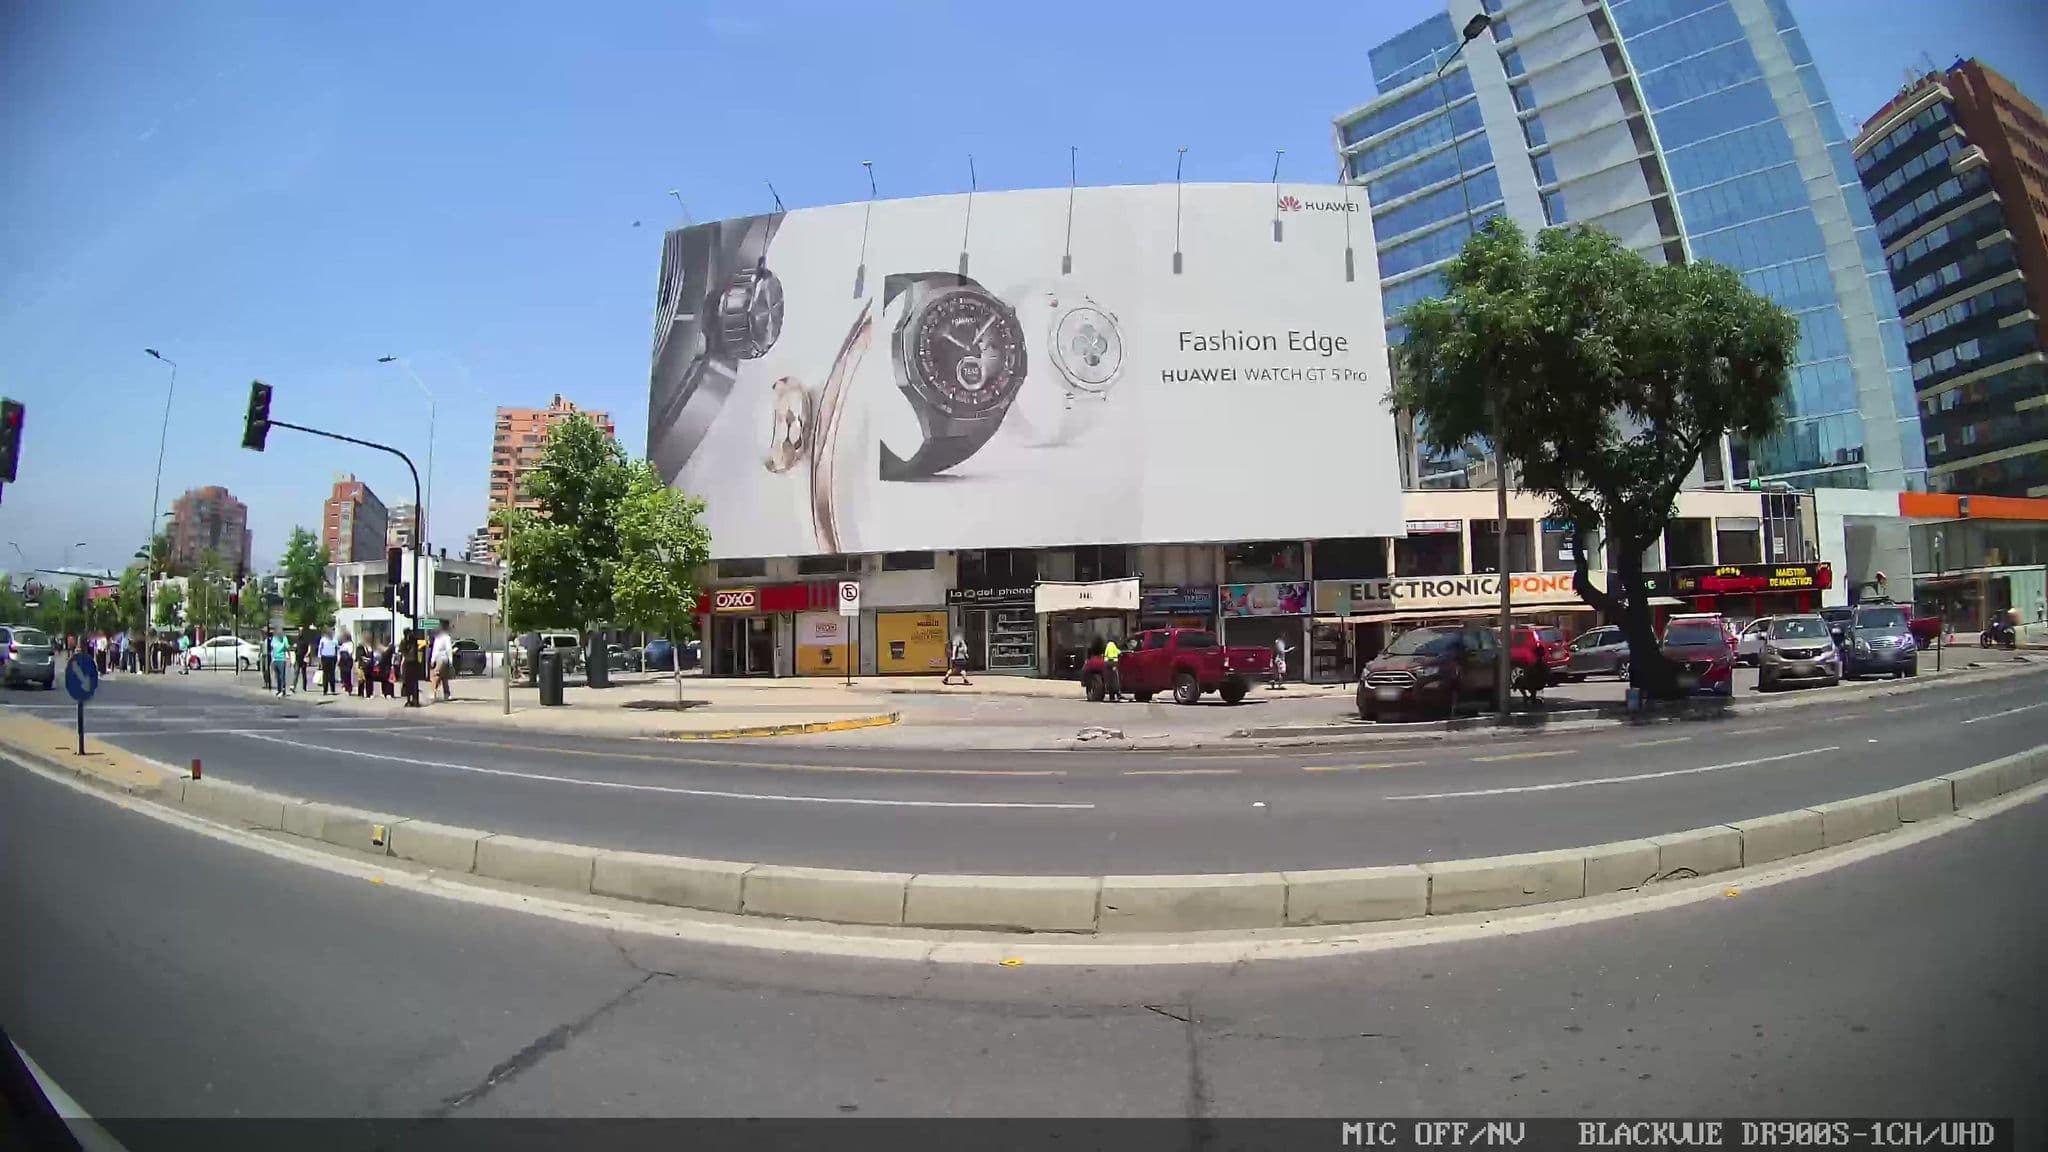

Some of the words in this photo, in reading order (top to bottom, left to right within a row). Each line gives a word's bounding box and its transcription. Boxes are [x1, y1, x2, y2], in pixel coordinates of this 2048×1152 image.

[1305, 201, 1360, 212] HUAWEI
[1179, 330, 1277, 351] Fashion
[1288, 330, 1349, 357] Edge
[1162, 368, 1237, 383] HUAWEI
[1244, 368, 1301, 381] WATCH
[1306, 368, 1326, 381] GT
[1331, 369, 1340, 381] 5
[1344, 369, 1368, 381] Pro
[1775, 567, 1807, 577] MAESTRO
[998, 587, 1033, 596] phone
[716, 592, 755, 607] OXXO
